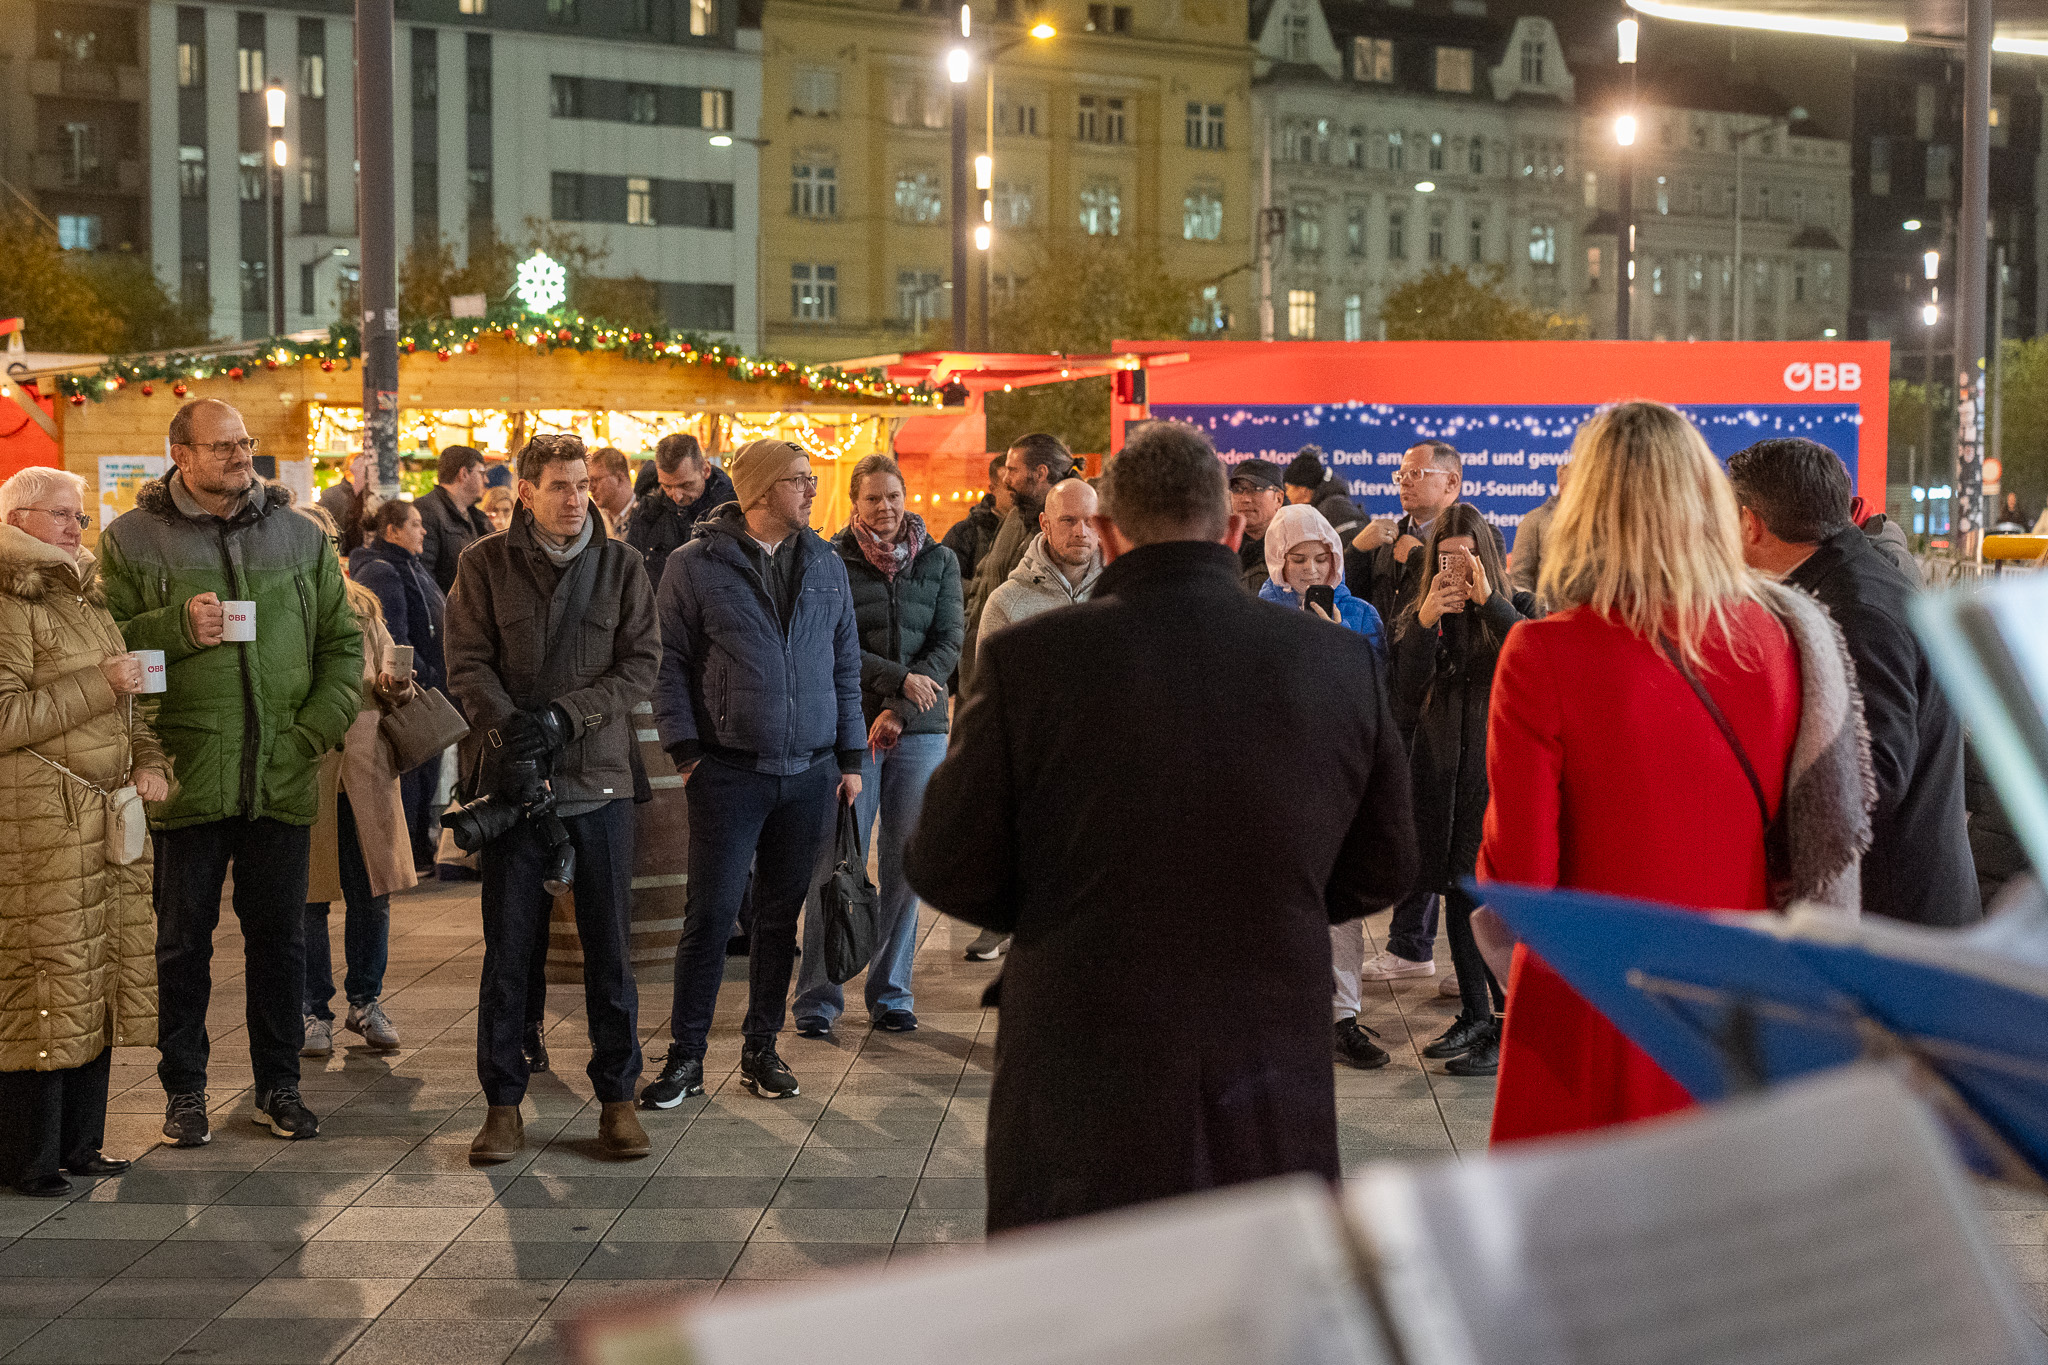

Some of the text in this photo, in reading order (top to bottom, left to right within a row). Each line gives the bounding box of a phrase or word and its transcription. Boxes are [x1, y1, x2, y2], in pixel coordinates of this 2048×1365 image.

[1216, 448, 1255, 465] eden
[1333, 449, 1373, 465] Dreh
[1492, 449, 1525, 466] und
[1461, 479, 1546, 496] DJ-Sounds
